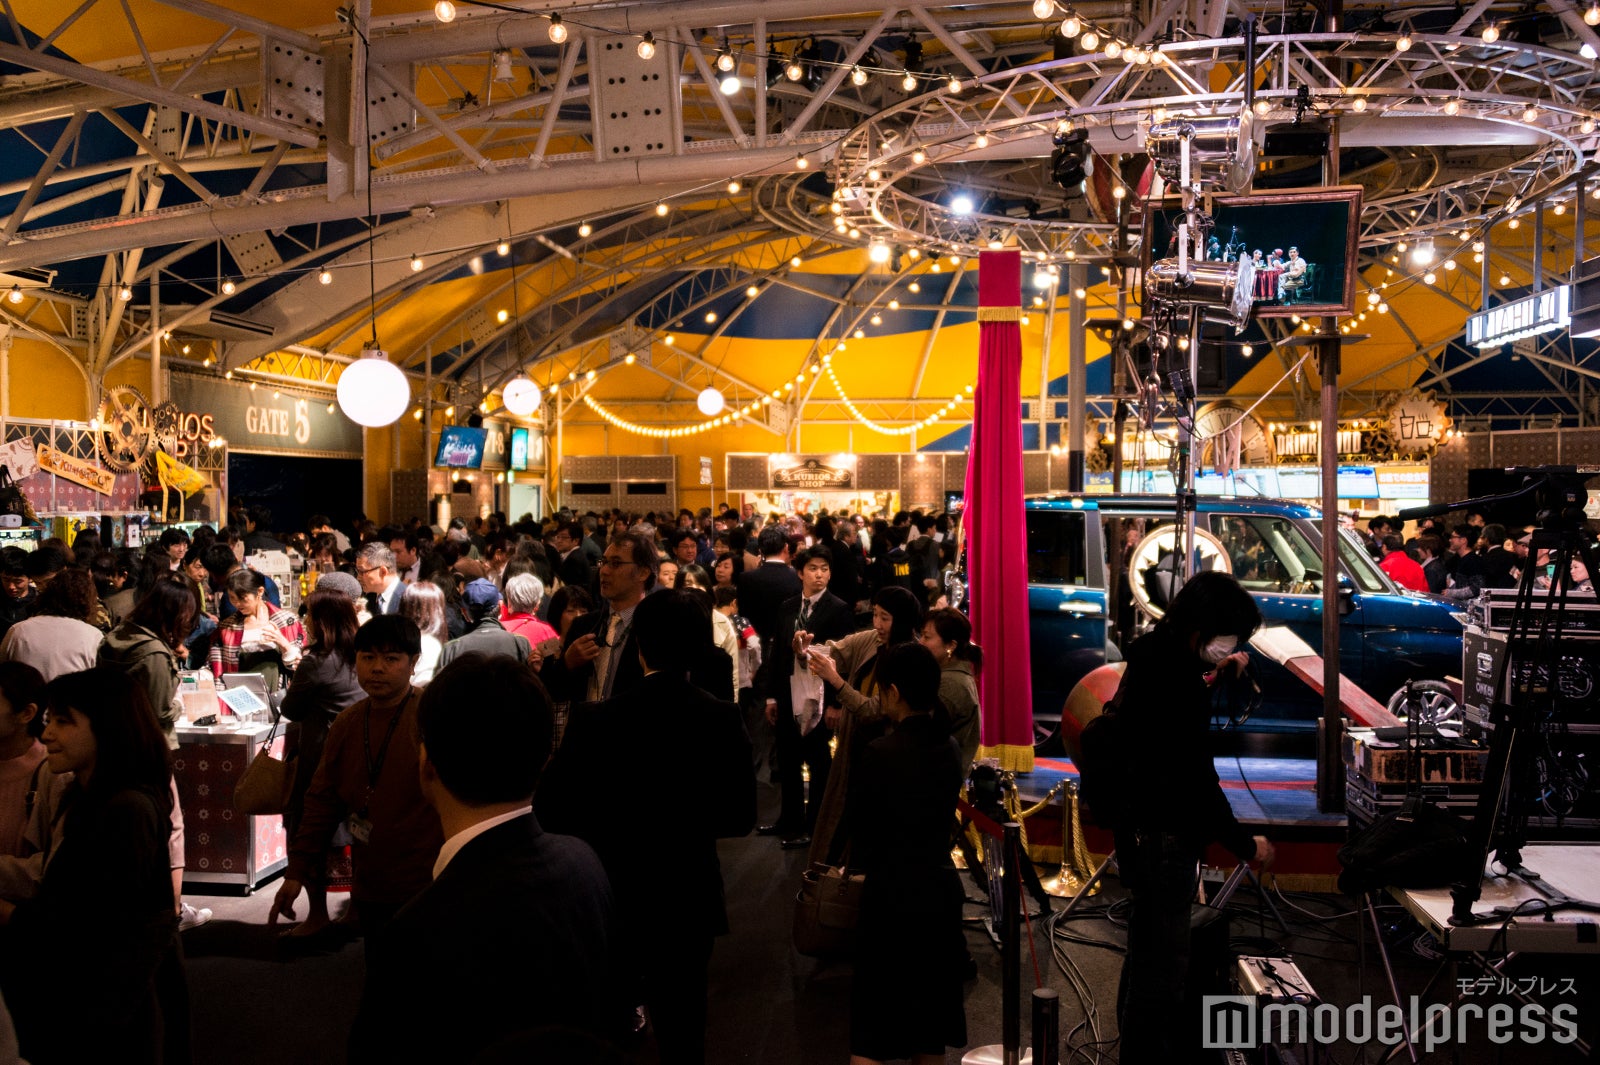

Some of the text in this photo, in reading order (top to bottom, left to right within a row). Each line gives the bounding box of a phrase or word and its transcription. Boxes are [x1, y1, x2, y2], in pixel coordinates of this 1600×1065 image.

[246, 400, 311, 444] GATE 5
[1277, 432, 1317, 455] DRINK
[793, 472, 831, 481] KURIOS
[798, 480, 826, 488] SHOP
